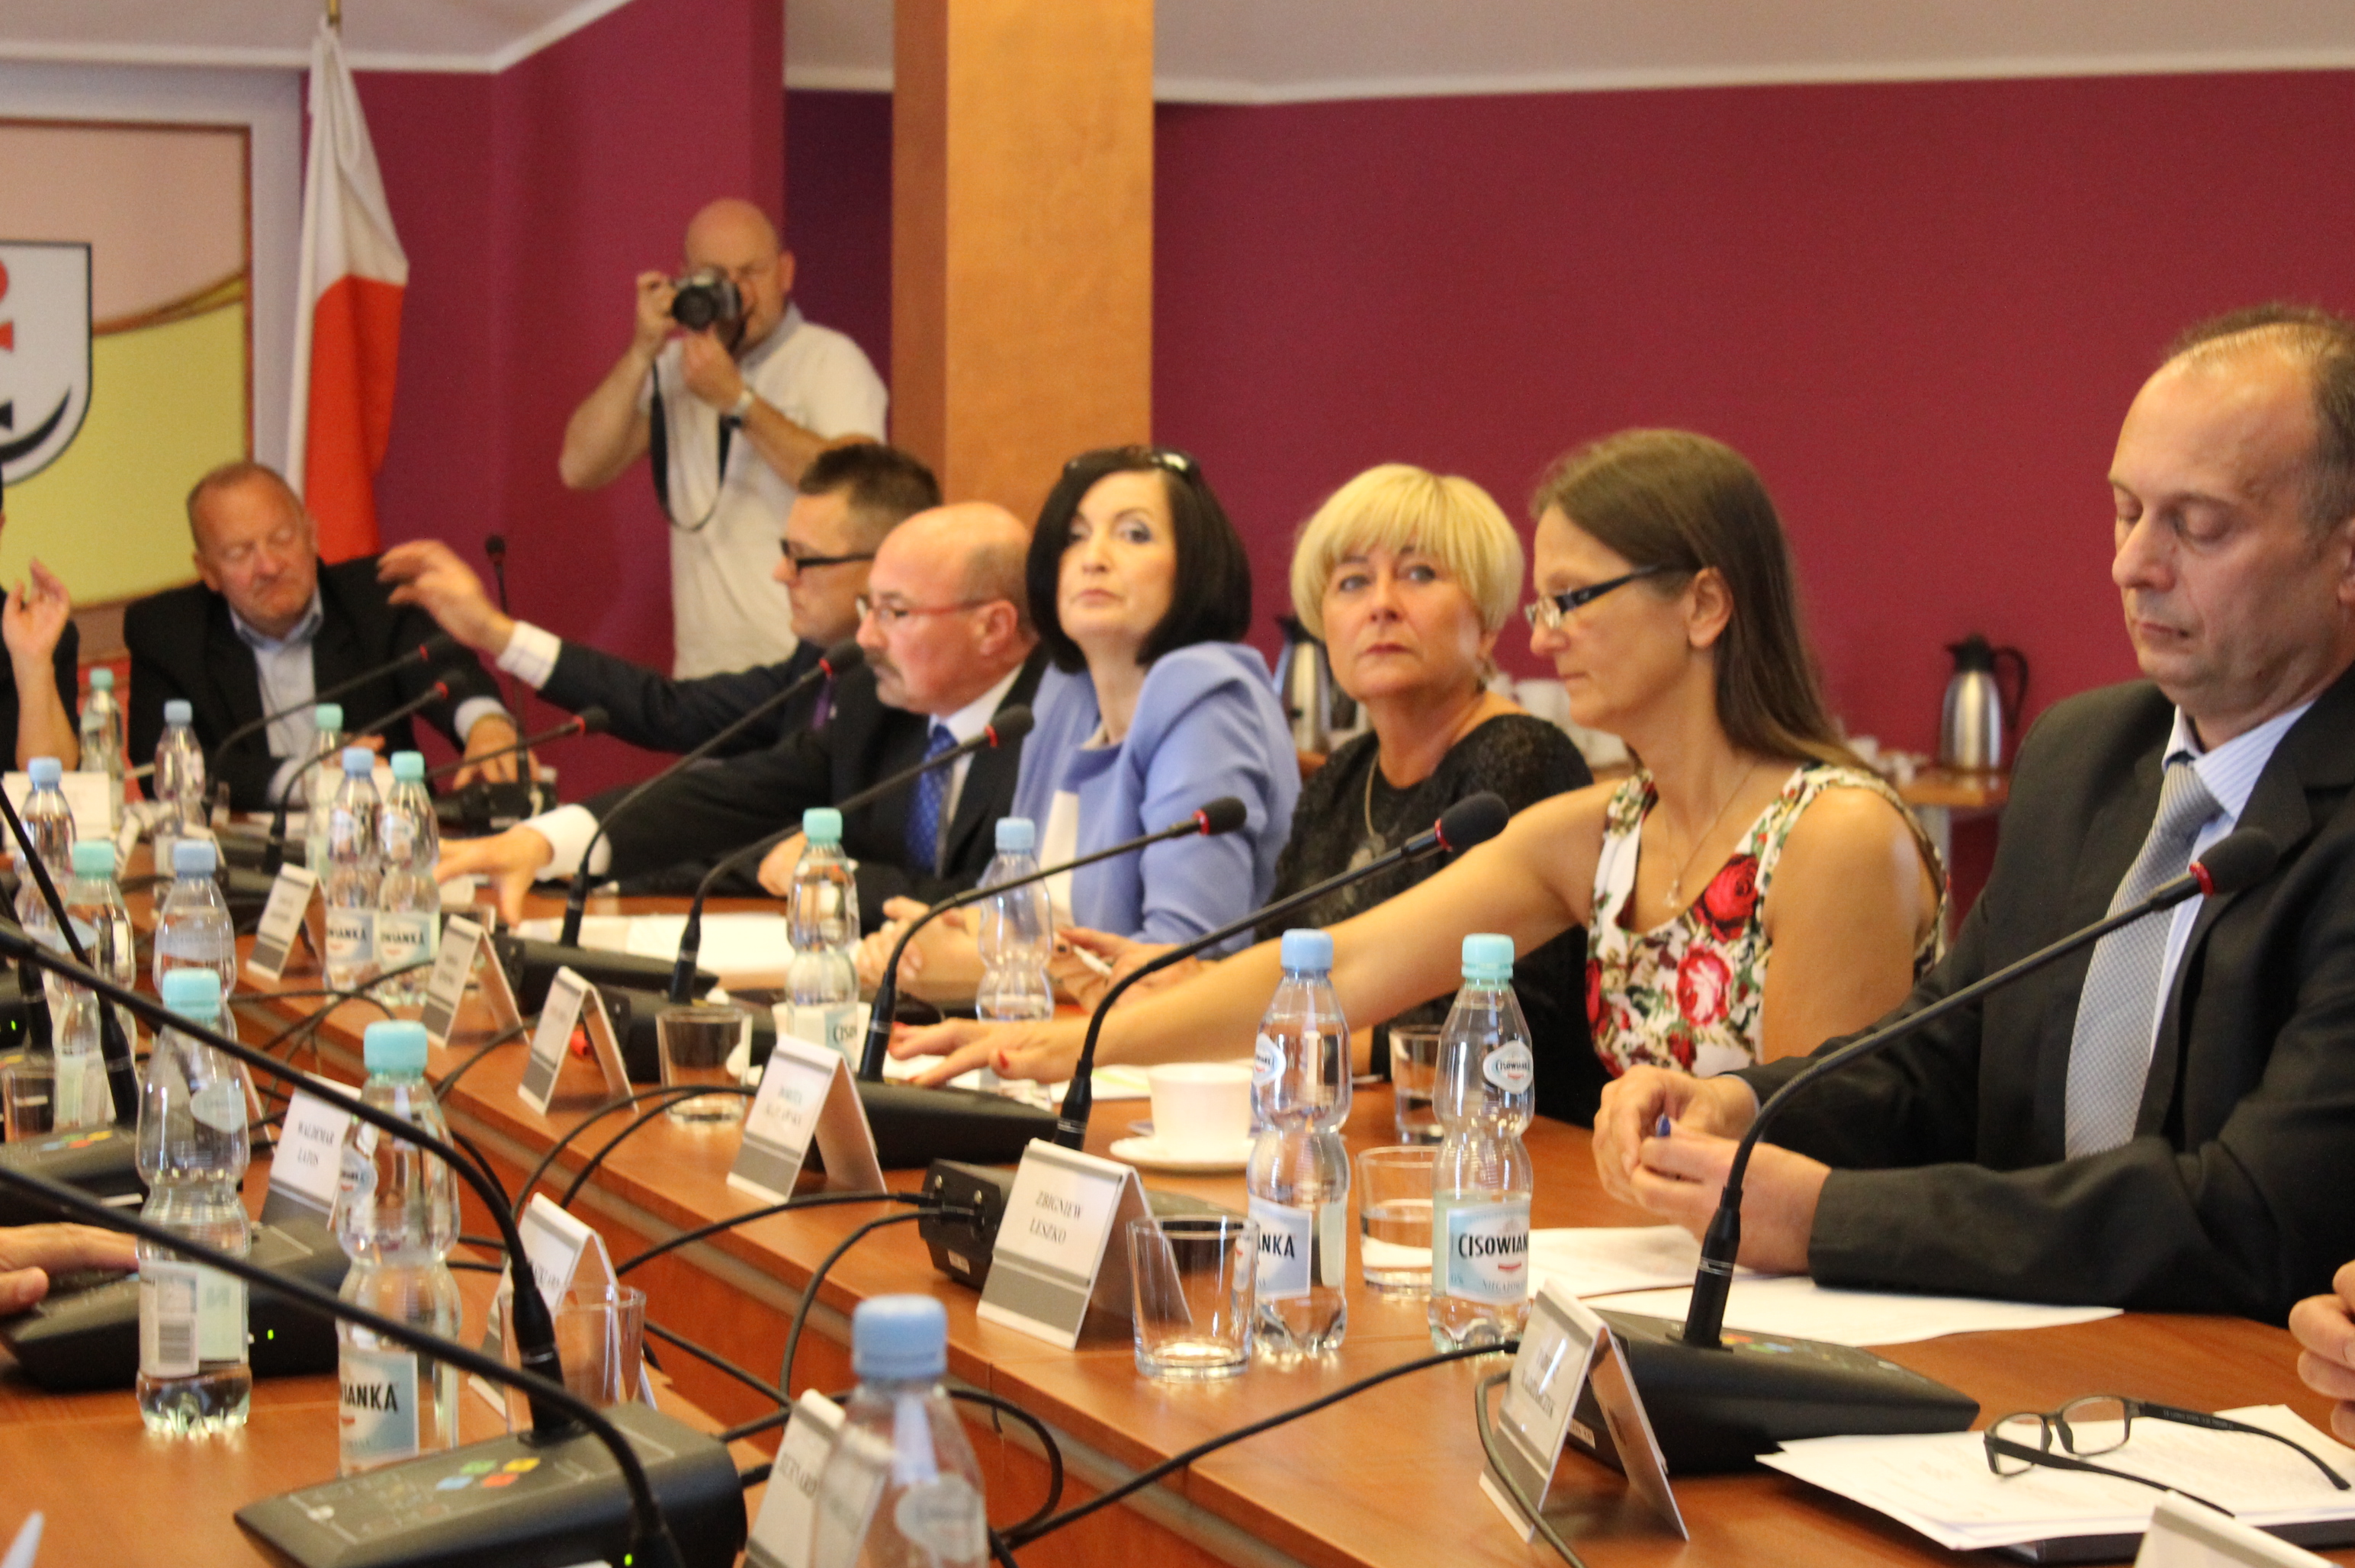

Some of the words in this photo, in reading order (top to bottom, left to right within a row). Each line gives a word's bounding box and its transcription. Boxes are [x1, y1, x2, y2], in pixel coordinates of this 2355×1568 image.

[1036, 1190, 1081, 1221] ZBIGNIEW
[1030, 1216, 1066, 1245] LESZKO
[340, 1382, 398, 1412] IANKA
